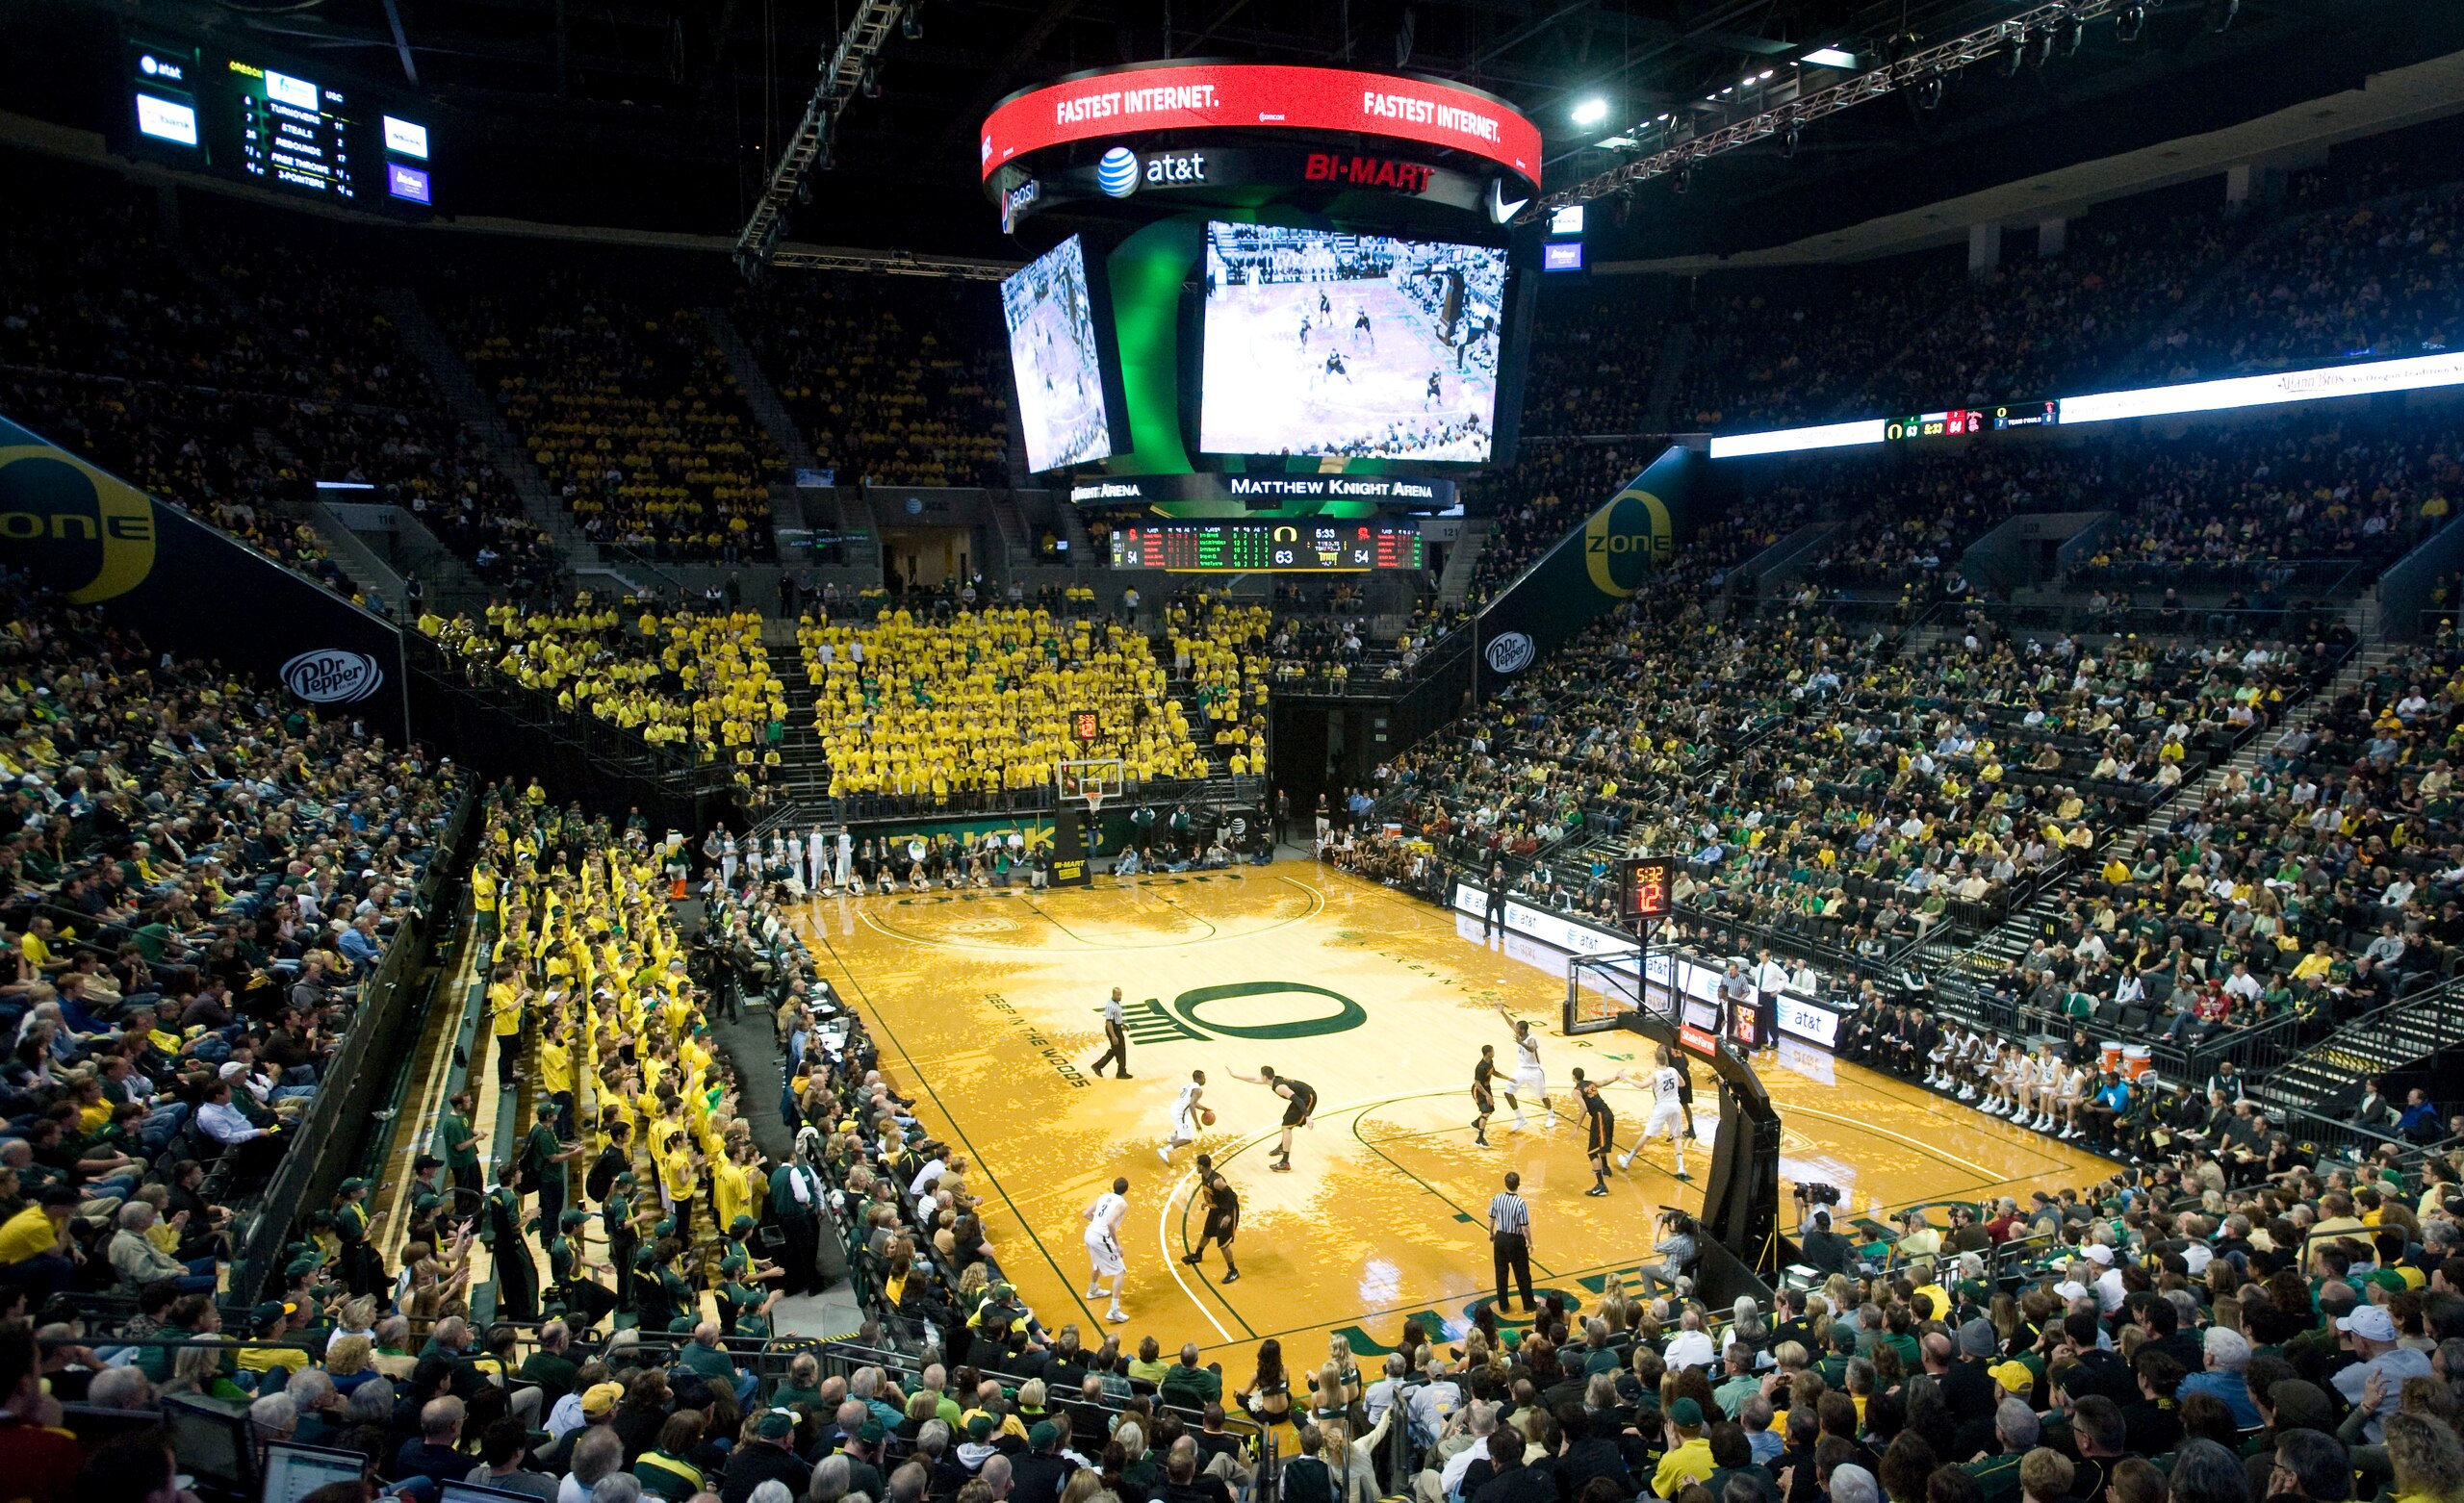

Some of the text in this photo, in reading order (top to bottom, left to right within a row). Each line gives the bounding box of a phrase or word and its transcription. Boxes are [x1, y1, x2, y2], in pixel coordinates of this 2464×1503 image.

[229, 61, 264, 79] OREGON
[325, 90, 344, 103] USC
[1057, 85, 1219, 124] FASTEST INTERNET.
[270, 103, 321, 124] TURNOVERS
[1364, 91, 1502, 143] FASTEST INTERNET.
[281, 122, 313, 139] STEALS
[275, 137, 322, 156] REBOUNDS
[271, 152, 295, 166] FREE
[295, 158, 330, 174] THROWS
[1147, 152, 1205, 181] at&t
[278, 169, 325, 190] 3-POINTERS
[1009, 181, 1034, 211] pepsi
[1923, 422, 1943, 435] 5:33
[1949, 421, 1962, 433] 54
[1100, 483, 1142, 497] ARENA
[1231, 478, 1432, 497] MATTHEW KNIGHT ARENA
[1315, 528, 1335, 538] 5:33
[1127, 550, 1138, 564] 54
[1275, 550, 1294, 564] 63
[1354, 549, 1369, 564] 54
[1504, 639, 1518, 653] Dr
[1492, 643, 1526, 668] Pepper
[318, 657, 346, 676] Dr
[293, 662, 363, 696] Pepper
[1078, 714, 1095, 724] 5:32
[1081, 724, 1093, 738] 12
[1636, 866, 1664, 883] 5:32
[1640, 882, 1661, 912] 12
[1520, 913, 1537, 929] at&t
[1579, 934, 1599, 951] at&t
[1647, 958, 1668, 977] at&t
[1794, 1010, 1822, 1032] at&t
[985, 993, 1091, 1088] DEEP IN THE WOODS
[1681, 1029, 1715, 1052] State Farm
[1663, 1077, 1676, 1092] 25
[1098, 1204, 1108, 1218] 3
